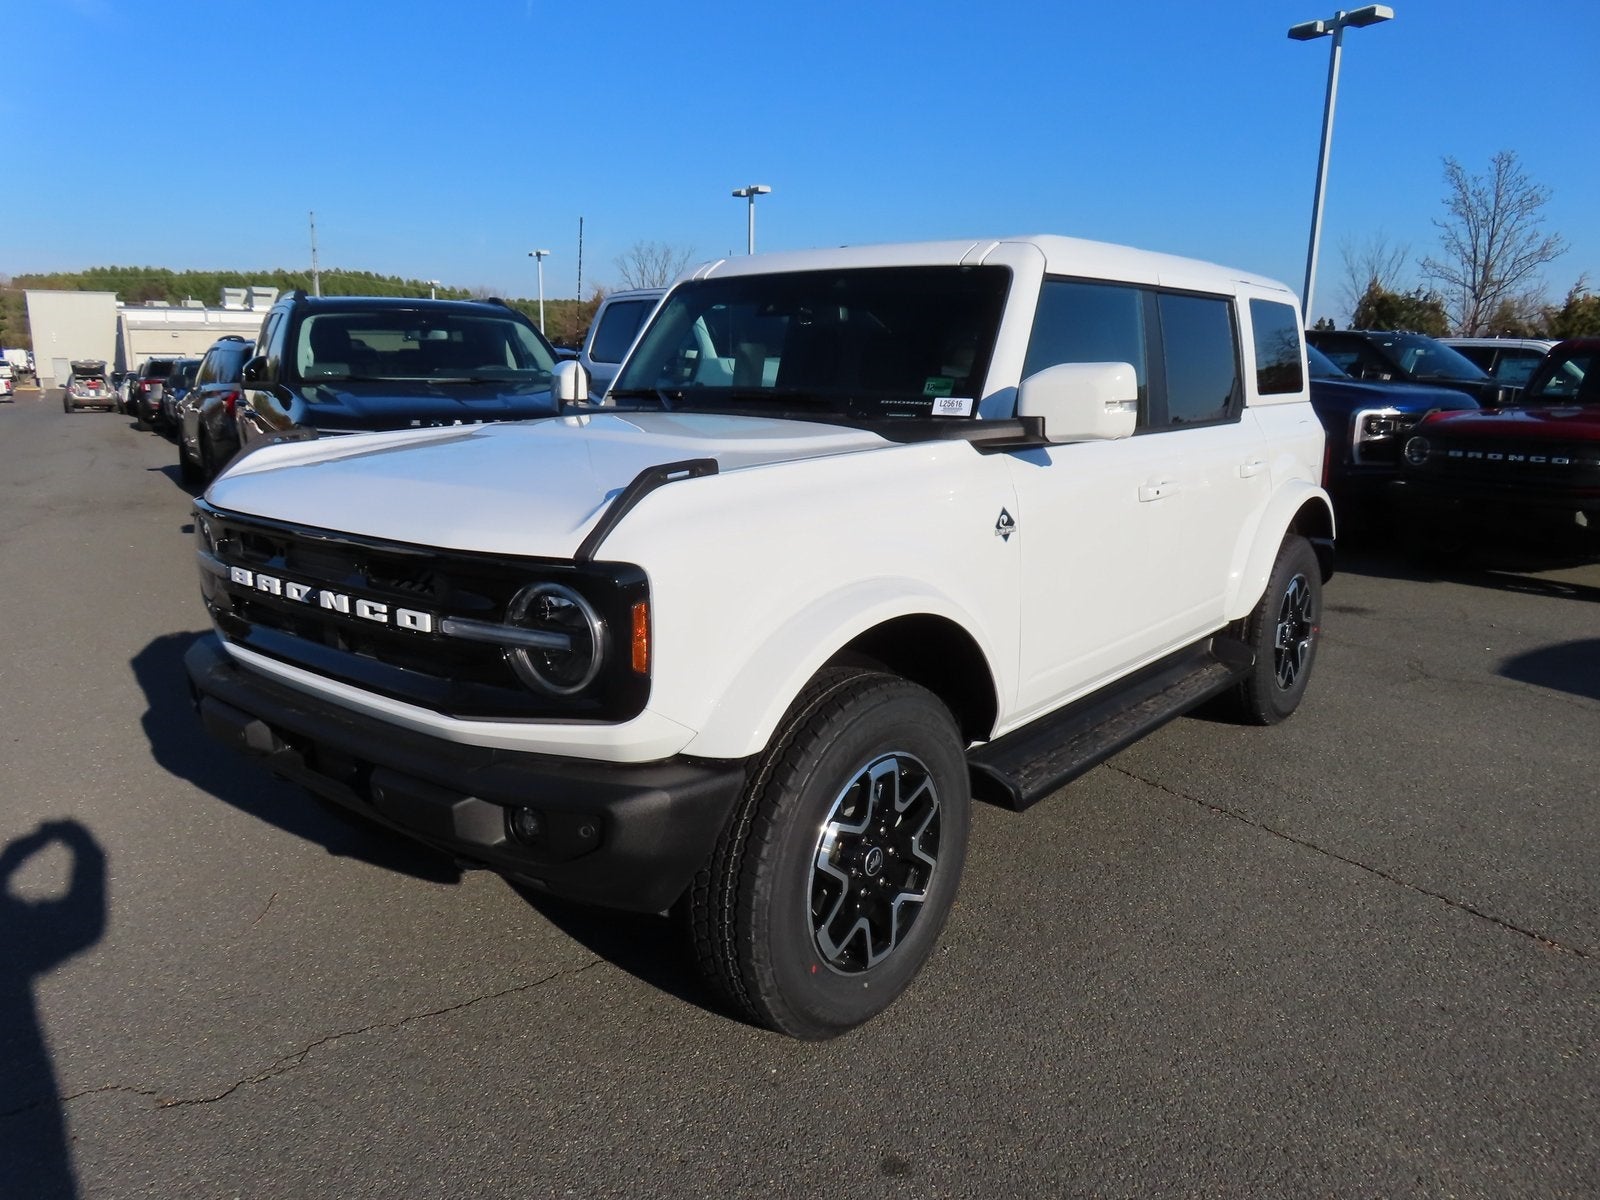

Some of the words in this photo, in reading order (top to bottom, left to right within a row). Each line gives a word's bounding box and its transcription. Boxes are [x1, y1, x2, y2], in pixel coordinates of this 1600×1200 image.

[939, 399, 963, 408] L25616
[1448, 450, 1569, 465] BRONCO
[230, 566, 432, 633] BRONCO
